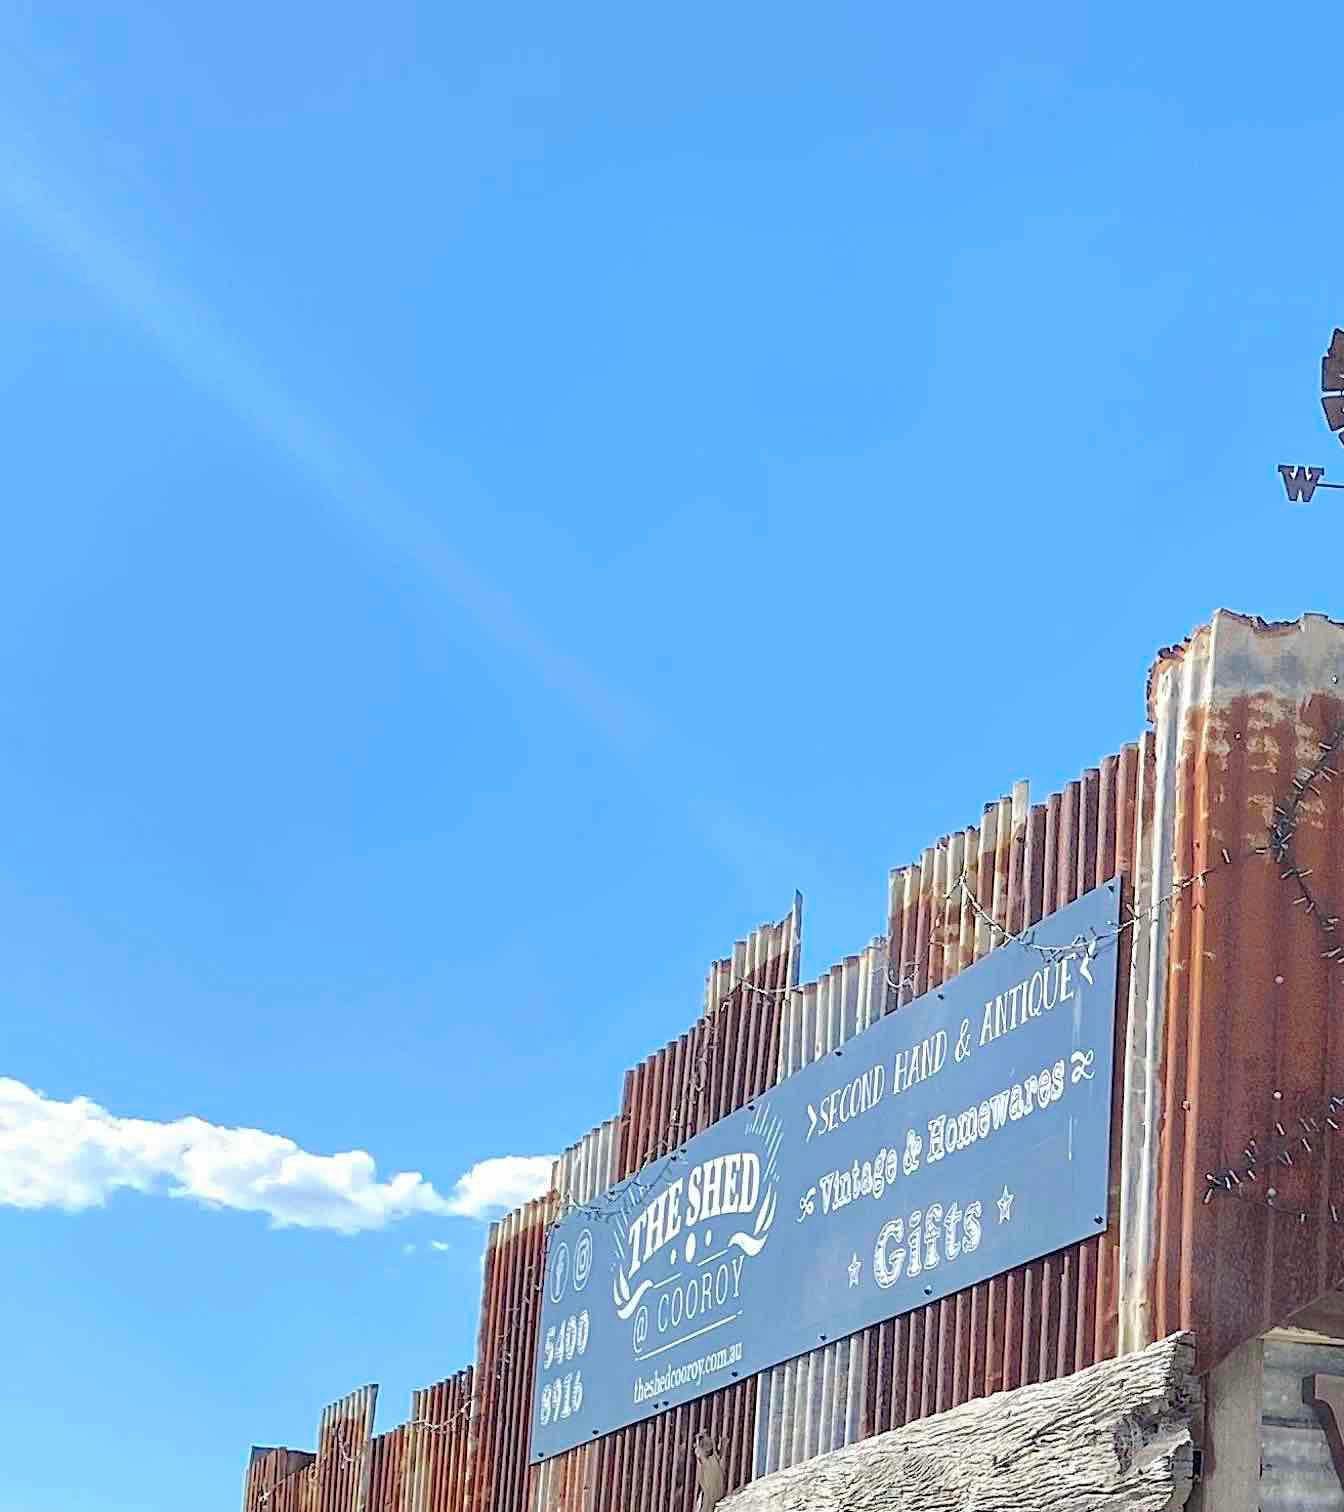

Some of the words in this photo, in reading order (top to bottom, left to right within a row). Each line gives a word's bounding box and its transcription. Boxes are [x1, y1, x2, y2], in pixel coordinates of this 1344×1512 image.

[1278, 465, 1324, 502] W
[818, 1064, 885, 1136] SECOND
[893, 1030, 946, 1095] HAND
[955, 1018, 972, 1060] &
[980, 961, 1074, 1049] ANTIQUE
[818, 1147, 898, 1217] Vintage
[902, 1128, 923, 1175] &
[927, 1061, 1066, 1163] Homewares
[626, 1179, 683, 1275] THE
[685, 1153, 760, 1226] SHED
[872, 1201, 983, 1291] Gifts
[543, 1310, 591, 1370] 5400
[632, 1305, 649, 1354] @
[656, 1255, 745, 1334] COOROY
[540, 1370, 583, 1425] 8916
[633, 1341, 743, 1403] theshedcooroy.com.au
